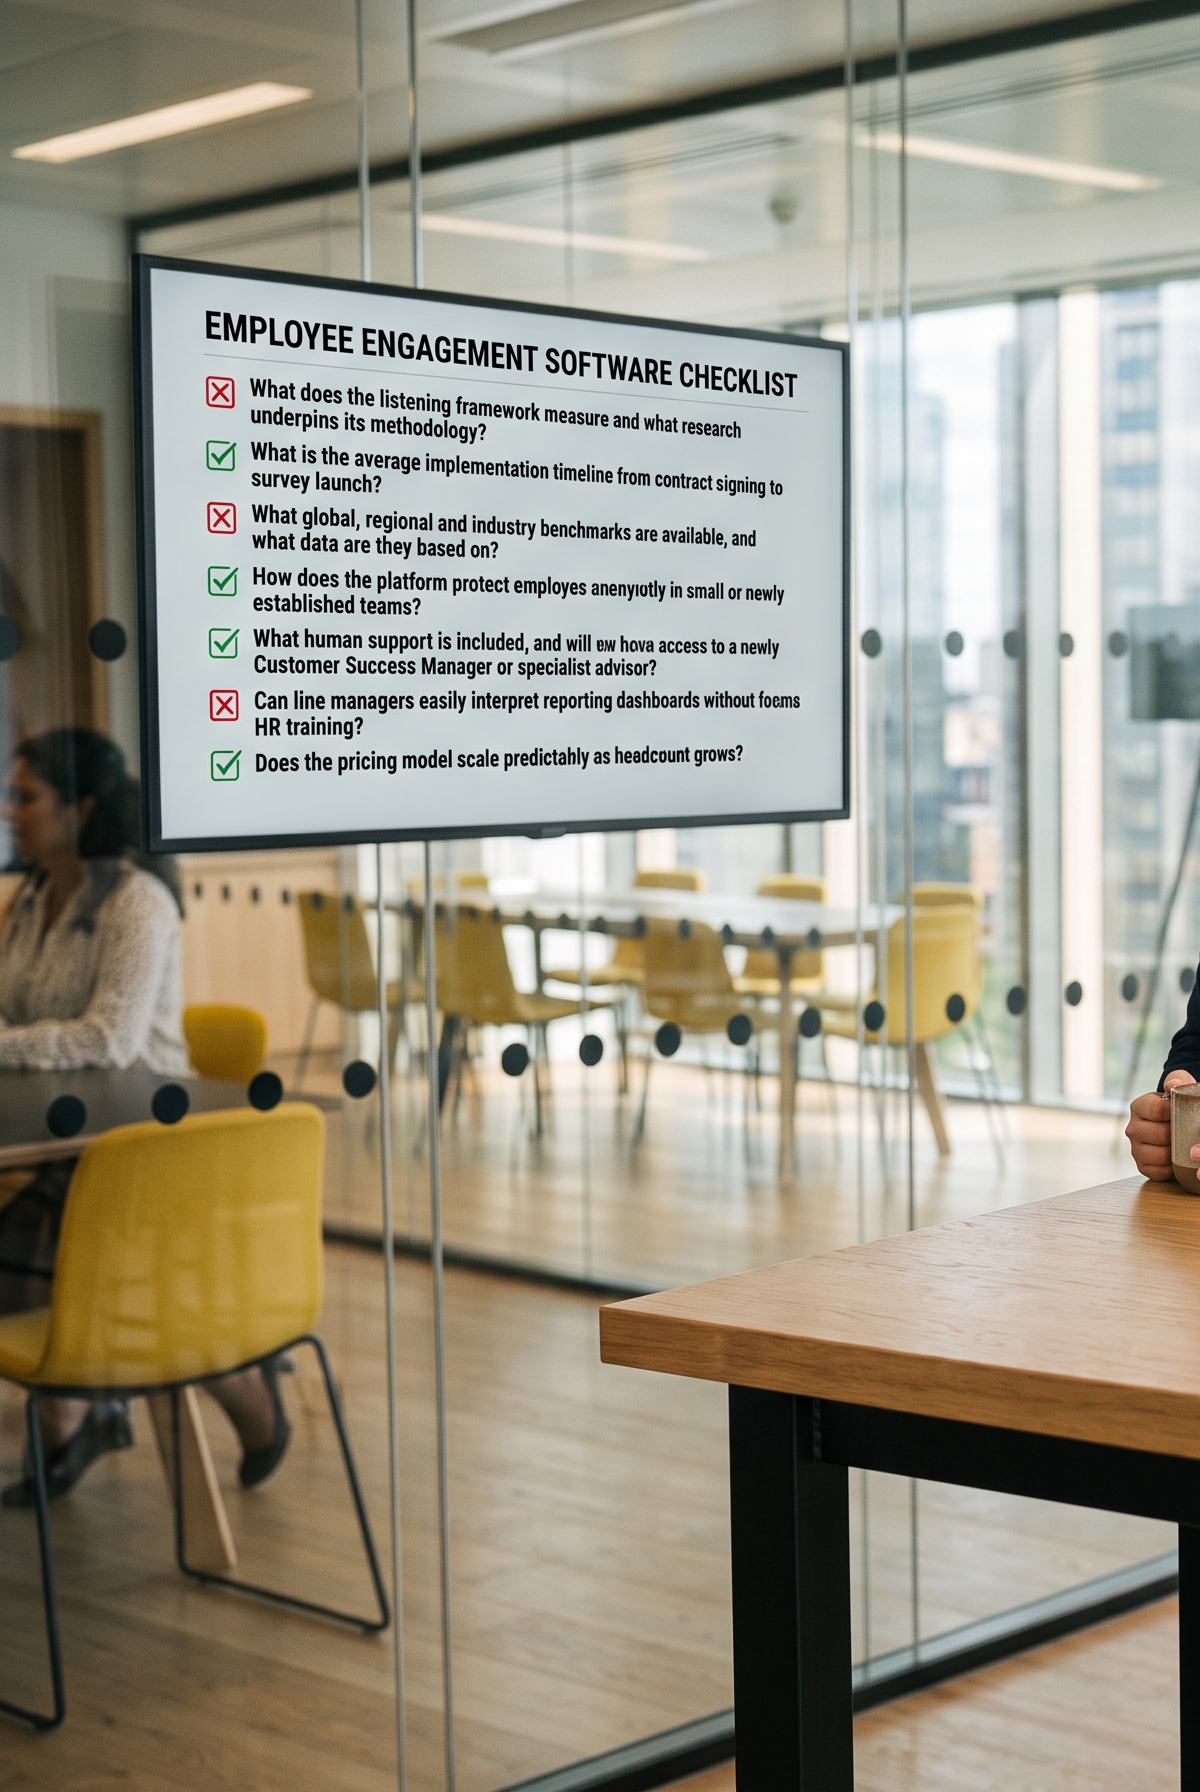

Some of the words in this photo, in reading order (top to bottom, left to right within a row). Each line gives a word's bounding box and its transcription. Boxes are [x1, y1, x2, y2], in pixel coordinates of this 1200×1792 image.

[206, 310, 354, 354] EMPLOYEE
[362, 328, 538, 372] ENGAGEMENT
[545, 348, 672, 386] SOFTWARE
[680, 362, 798, 398] CHECKLIST
[250, 378, 296, 400] What
[301, 382, 342, 404] does
[347, 386, 375, 407] the
[380, 389, 451, 418] listening
[456, 396, 540, 421] framework
[545, 409, 609, 427] measure
[613, 412, 639, 430] and
[644, 414, 678, 433] what
[682, 421, 741, 438] research
[251, 406, 339, 432] underpins
[344, 412, 365, 432] its
[371, 416, 486, 444] methodology?
[251, 441, 297, 463] What
[302, 444, 317, 464] is
[321, 446, 349, 466] the
[355, 453, 421, 475] average
[426, 453, 549, 479] implementation
[553, 462, 613, 483] timeline
[617, 467, 650, 486] from
[655, 473, 713, 491] contract
[716, 475, 766, 499] signing
[769, 480, 783, 495] to
[251, 472, 310, 494] survey
[316, 471, 382, 493] launch?
[252, 504, 297, 525] What
[302, 507, 360, 531] global,
[366, 511, 433, 534] regional
[438, 514, 467, 533] and
[472, 515, 536, 540] industry
[541, 519, 631, 540] benchmarks
[635, 528, 658, 542] are
[662, 527, 727, 549] available,
[732, 530, 756, 547] and
[252, 530, 295, 550] what
[300, 532, 338, 552] data
[344, 539, 371, 553] are
[375, 535, 412, 560] they
[417, 537, 465, 557] based
[470, 541, 498, 558] on?
[253, 567, 292, 586] How
[297, 567, 339, 588] does
[344, 569, 372, 589] the
[377, 571, 447, 594] platform
[453, 576, 510, 596] protect
[670, 581, 682, 598] in
[687, 582, 724, 599] small
[728, 587, 742, 600] or
[746, 584, 784, 606] newly
[253, 593, 355, 614] established
[360, 597, 421, 615] teams?
[253, 628, 299, 648] What
[304, 628, 362, 648] human
[368, 633, 433, 654] support
[438, 631, 452, 650] is
[457, 631, 529, 655] included,
[534, 633, 561, 651] and
[566, 634, 591, 652] will
[659, 640, 707, 654] access
[711, 639, 725, 654] to
[729, 642, 737, 654] a
[741, 638, 779, 659] newly
[254, 655, 340, 674] Customer
[346, 656, 416, 674] Success
[422, 657, 492, 680] Manager
[497, 662, 513, 675] or
[518, 657, 591, 680] specialist
[595, 658, 657, 676] advisor?
[255, 691, 288, 710] Can
[294, 690, 325, 710] line
[331, 695, 414, 714] managers
[419, 690, 466, 714] easily
[472, 690, 539, 714] interpret
[544, 691, 612, 713] reporting
[617, 690, 700, 709] dashboards
[704, 691, 755, 708] without
[255, 717, 281, 736] HR
[286, 716, 363, 740] training?
[256, 753, 299, 772] Does
[304, 751, 332, 771] the
[338, 750, 397, 776] pricing
[402, 749, 452, 769] model
[457, 749, 499, 768] scale
[594, 751, 610, 764] as
[615, 745, 690, 764] headcount
[694, 745, 743, 767] grows?
